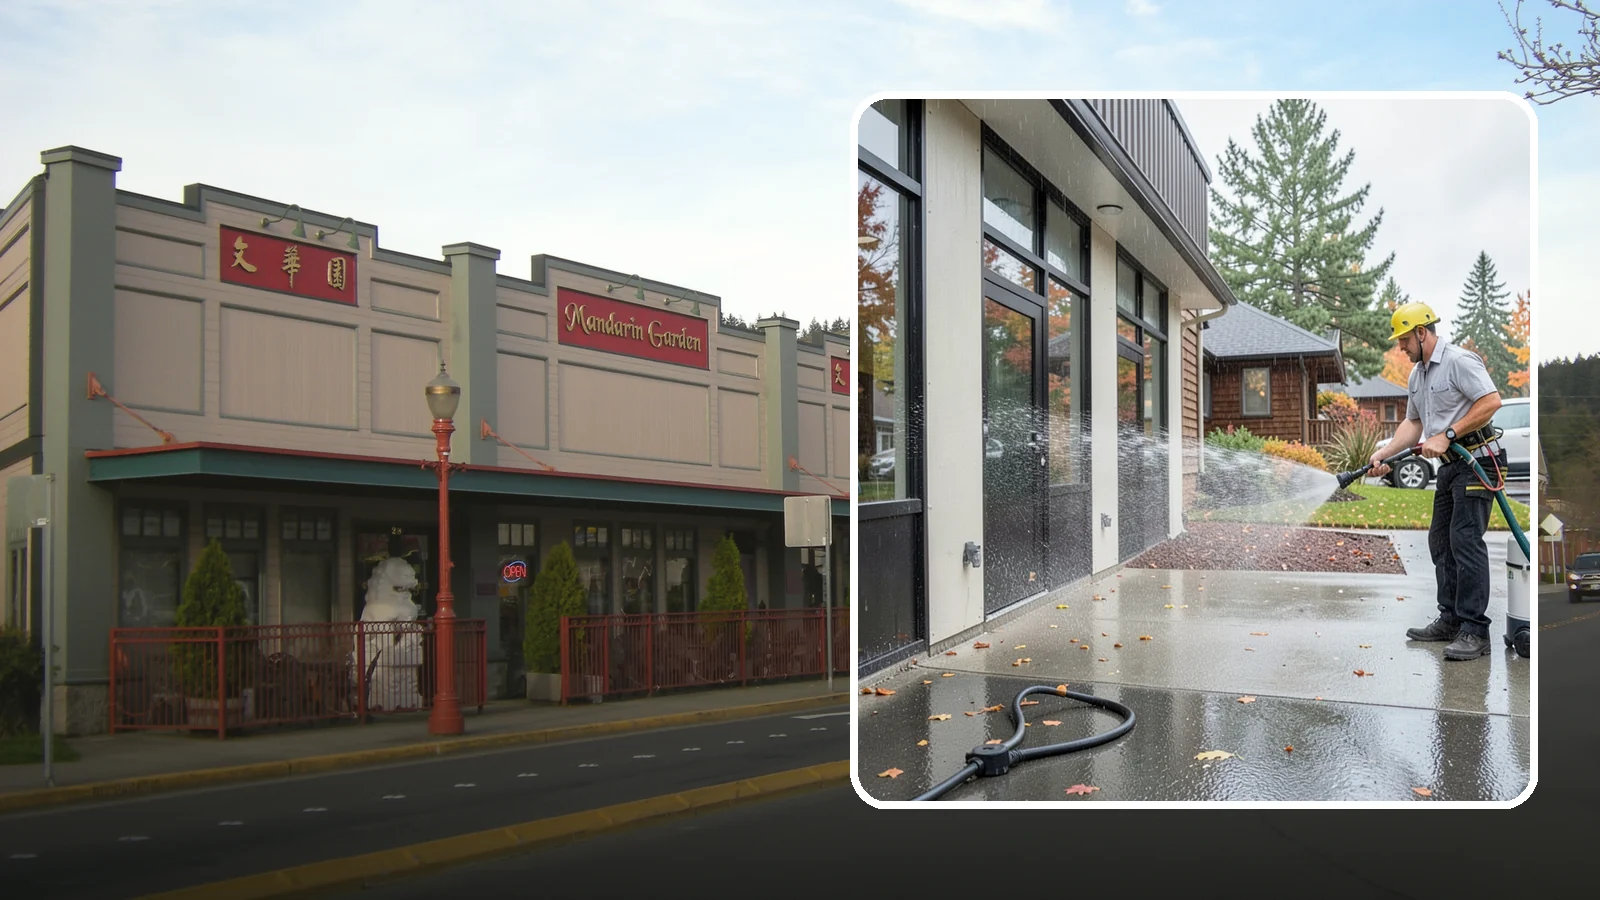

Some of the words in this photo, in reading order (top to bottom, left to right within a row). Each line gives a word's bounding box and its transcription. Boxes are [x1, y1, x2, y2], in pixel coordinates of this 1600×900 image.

[231, 235, 346, 290] 文華園
[564, 302, 644, 341] Mandarin
[647, 320, 702, 352] Garden
[503, 565, 527, 579] OPEN
